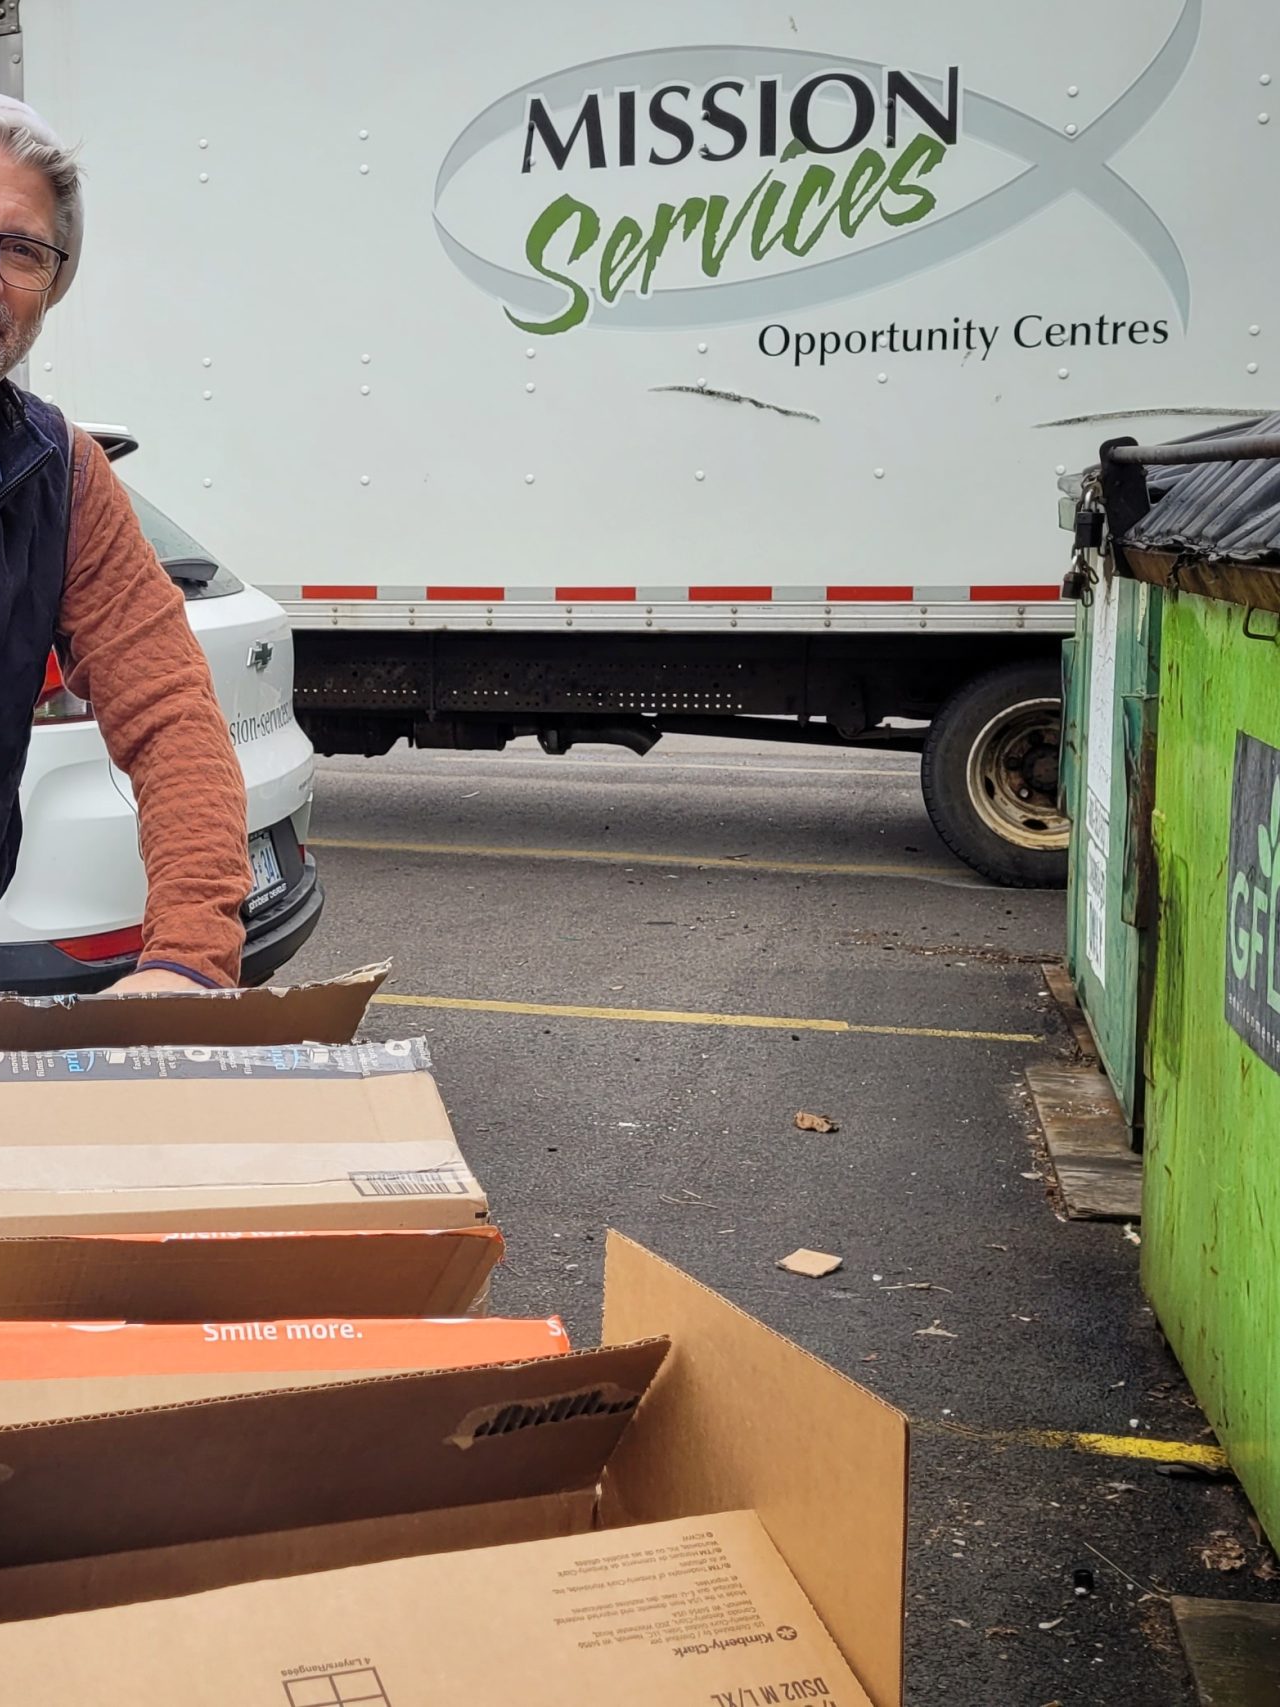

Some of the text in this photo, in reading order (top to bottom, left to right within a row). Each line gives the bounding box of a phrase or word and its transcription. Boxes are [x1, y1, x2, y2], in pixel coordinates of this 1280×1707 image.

[521, 66, 960, 174] MISSION
[502, 132, 948, 336] Services
[757, 312, 1169, 366] Opportunity Centres
[202, 1322, 364, 1342] Smile more.
[672, 1631, 774, 1659] Kimberly-Clark
[758, 1685, 781, 1704] M
[778, 1677, 831, 1702] DSU2
